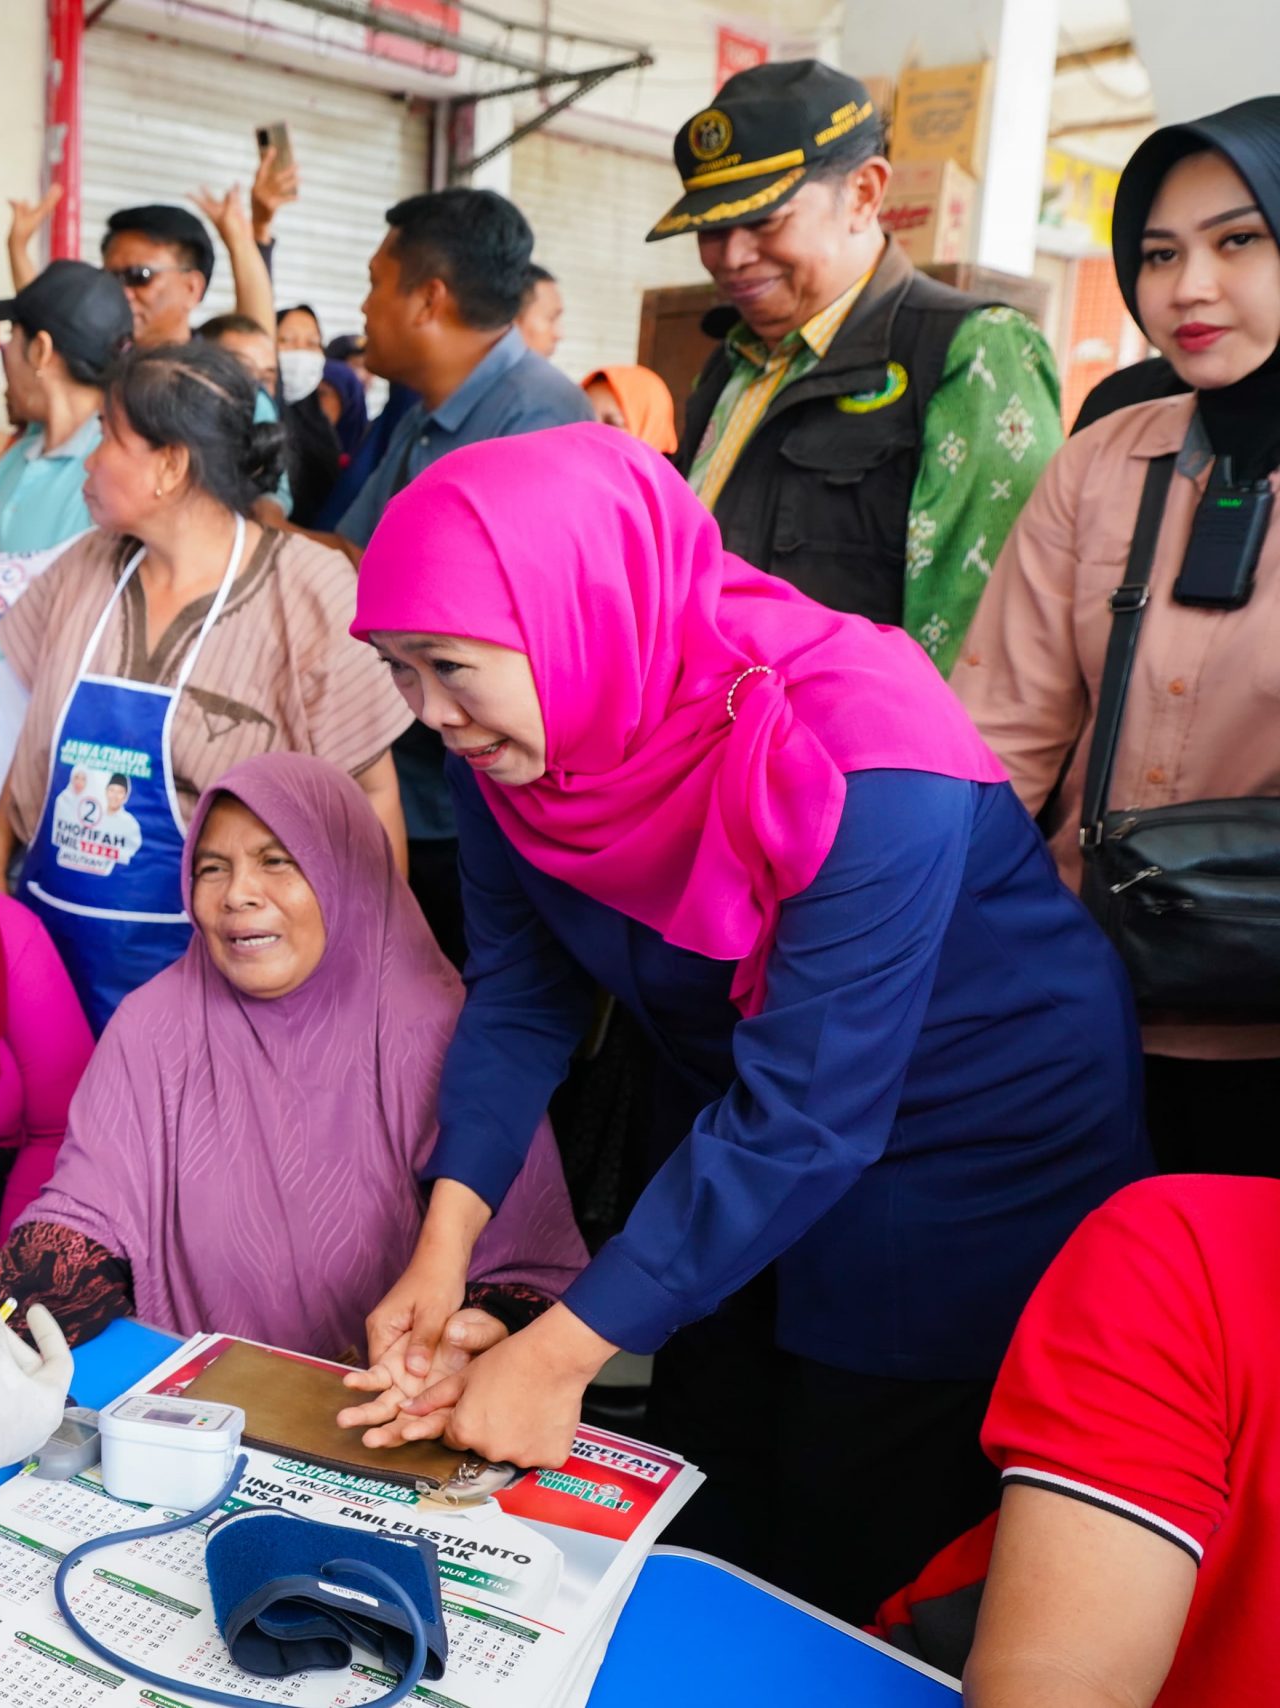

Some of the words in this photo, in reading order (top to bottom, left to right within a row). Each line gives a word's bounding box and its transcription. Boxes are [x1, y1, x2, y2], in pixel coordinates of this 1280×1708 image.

[83, 800, 96, 823] 2
[57, 819, 125, 848] KHOFIFAH
[571, 1440, 660, 1472] HOFIFAH
[536, 1468, 596, 1489] SAHABAT
[537, 1476, 583, 1497] NING
[246, 1477, 314, 1504] INDAR
[286, 1476, 388, 1508] LANJUTKAN!!
[339, 1507, 388, 1528] EMIL
[391, 1521, 532, 1566] ELESTIANTO
[468, 1573, 511, 1592] JATIM
[233, 1672, 245, 1681] 23
[248, 1678, 261, 1686] 24
[477, 1660, 490, 1668] 25
[496, 1669, 509, 1677] 26
[22, 1690, 34, 1698] 22
[224, 1681, 238, 1689] 30
[12, 1698, 24, 1706] 29
